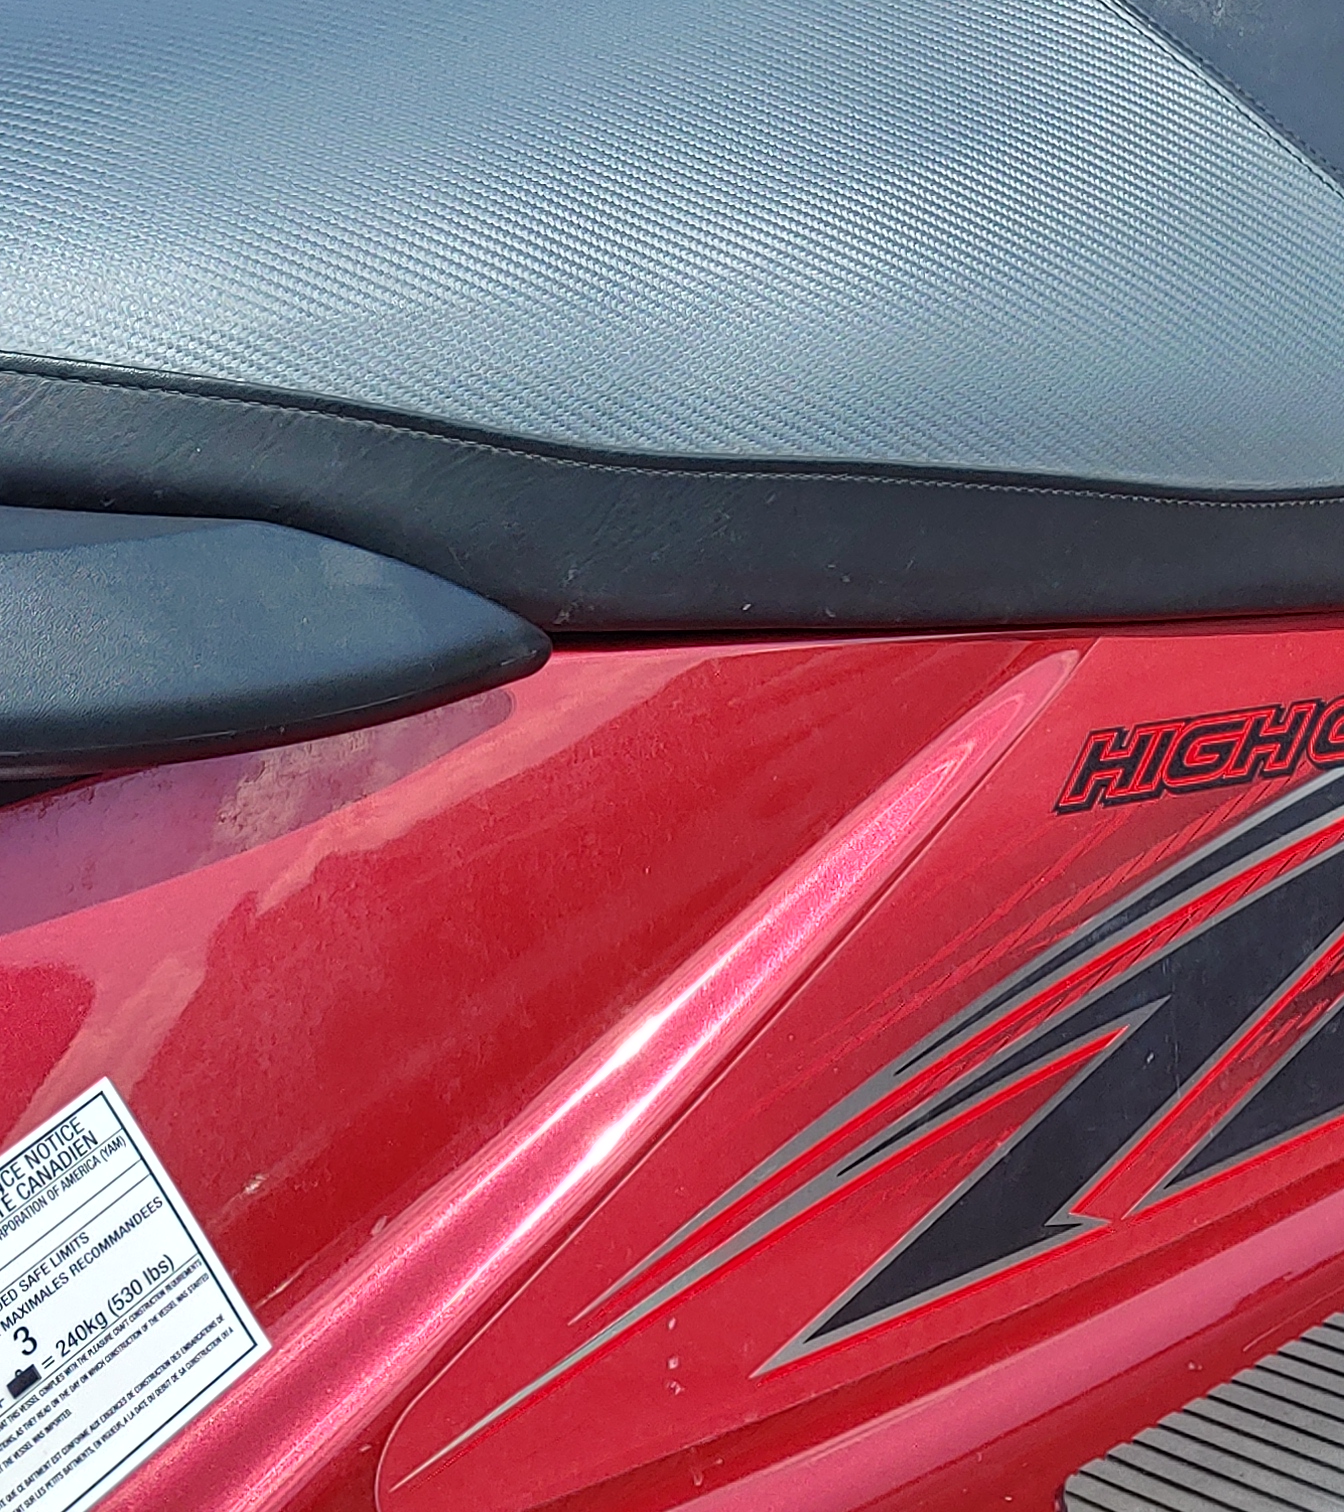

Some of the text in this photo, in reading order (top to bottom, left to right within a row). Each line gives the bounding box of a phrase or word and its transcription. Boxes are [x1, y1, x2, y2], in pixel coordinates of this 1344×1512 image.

[16, 1130, 99, 1200] CANADIEN
[23, 1116, 85, 1170] NOTICE
[46, 1184, 59, 1201] OF
[60, 1155, 102, 1192] AMERICA
[99, 1135, 127, 1162] (YAM)
[0, 1271, 70, 1332] MAXIMALES
[68, 1196, 163, 1277] RECOMMANDEES
[18, 1262, 51, 1293] SAFE
[49, 1231, 90, 1268] LIMITS
[55, 1254, 175, 1358] 240kg (530 lbs)
[5, 1409, 21, 1423] THIS
[76, 1352, 90, 1366] THE
[112, 1318, 130, 1337] CRAFT
[12, 1326, 38, 1356] 3
[68, 1379, 81, 1393] DAY
